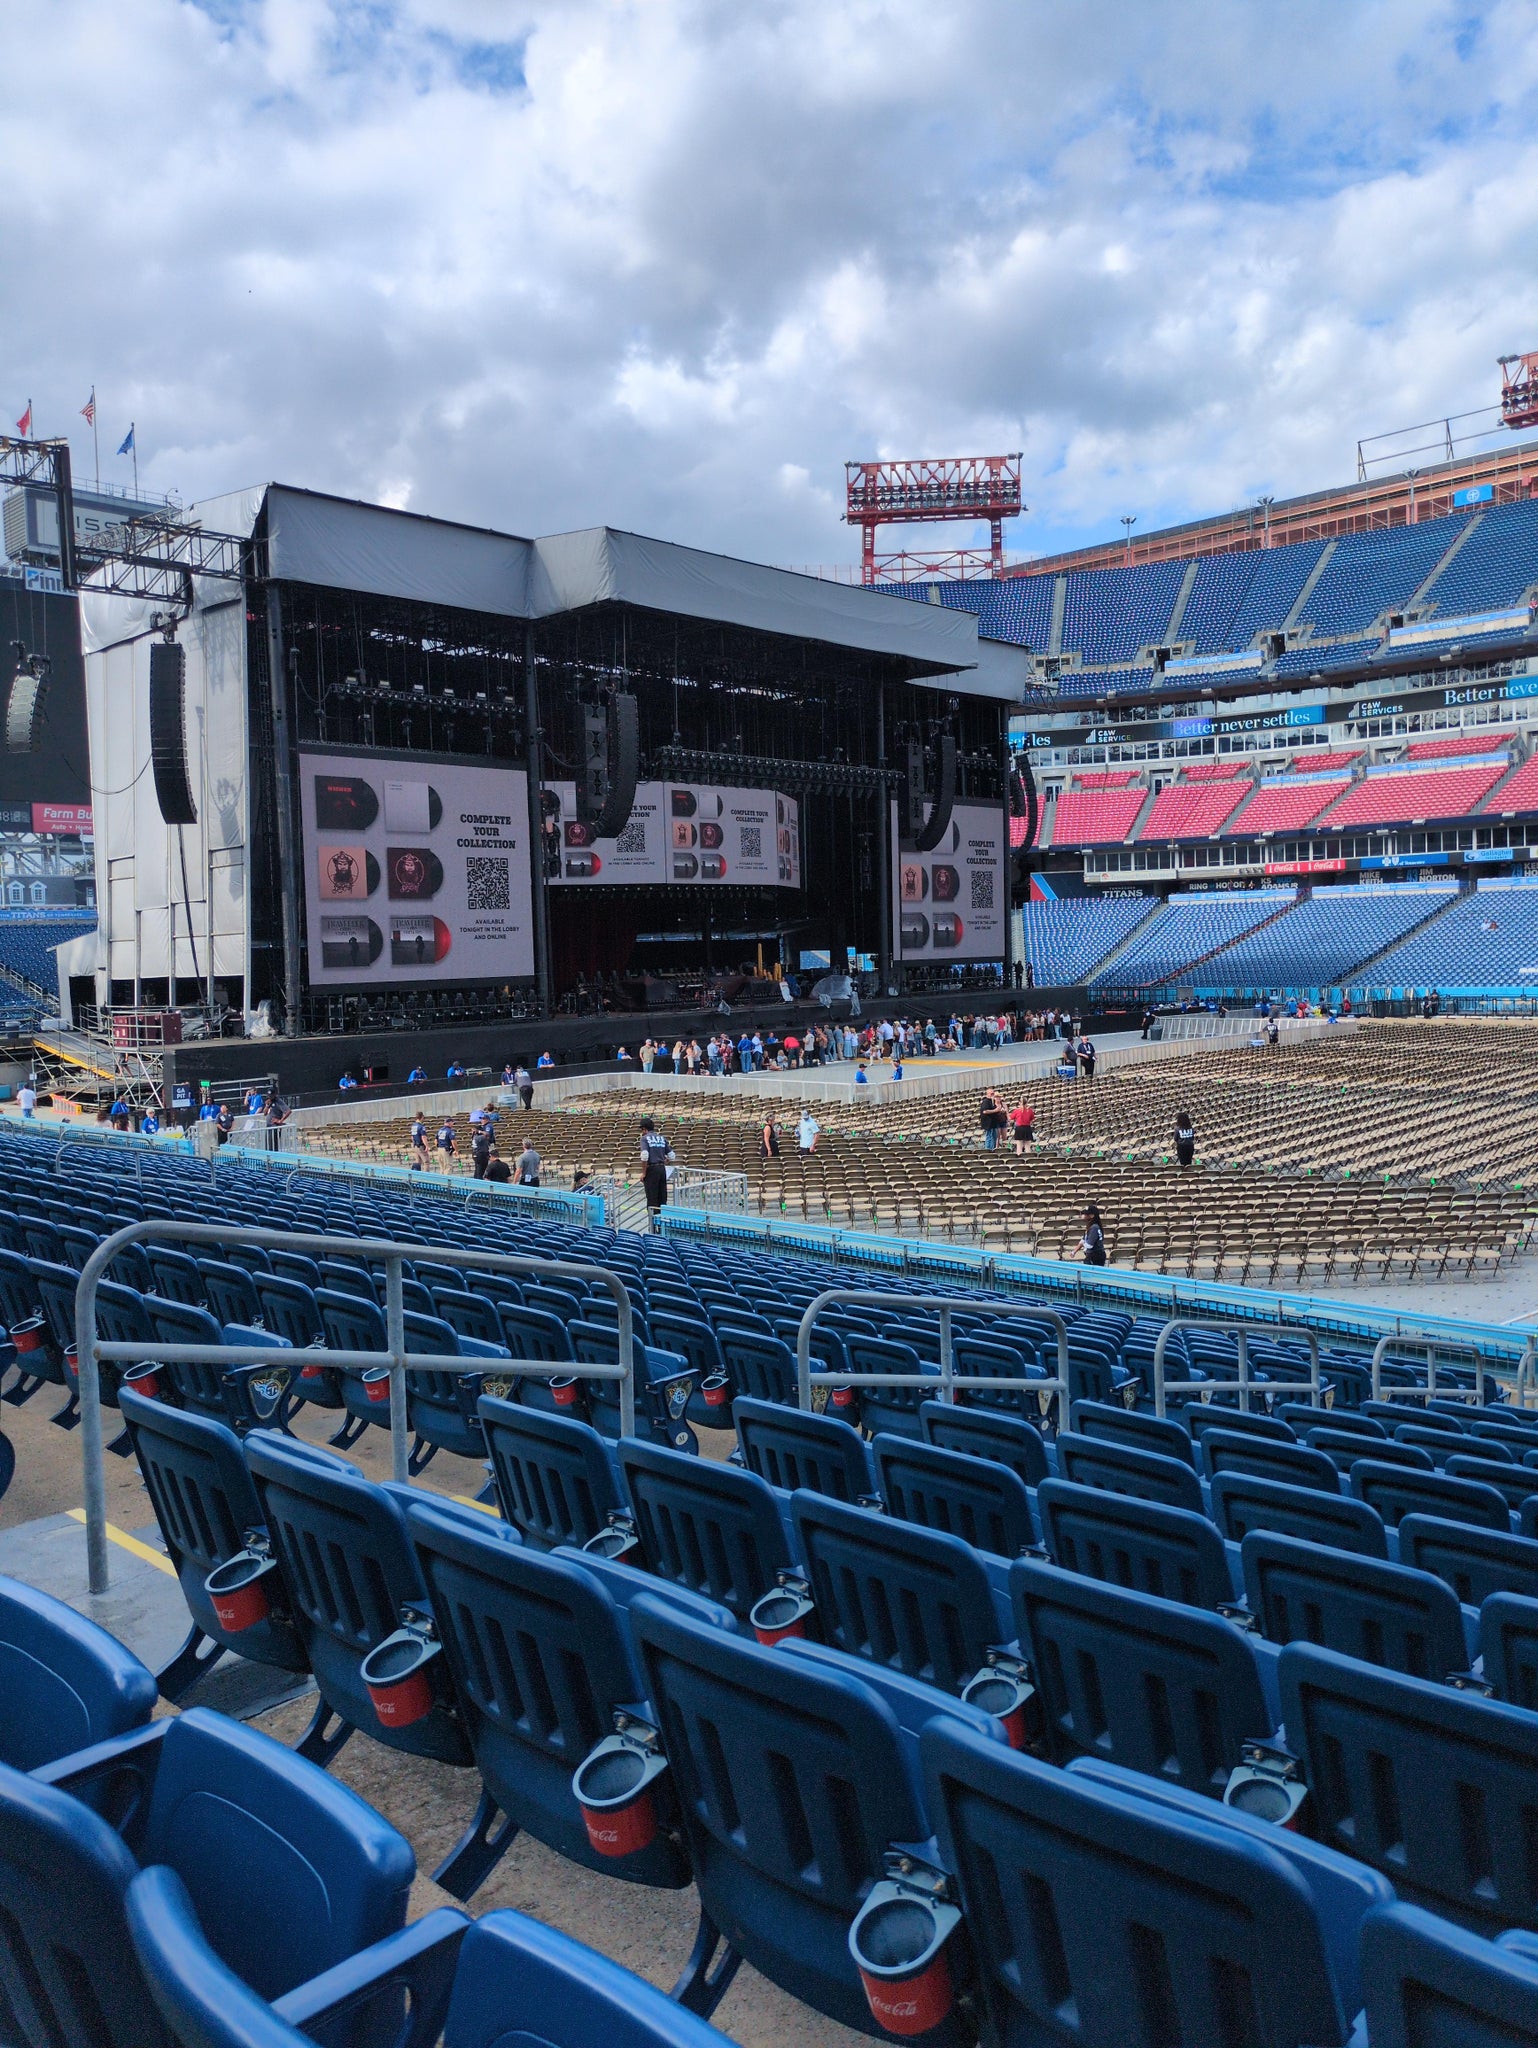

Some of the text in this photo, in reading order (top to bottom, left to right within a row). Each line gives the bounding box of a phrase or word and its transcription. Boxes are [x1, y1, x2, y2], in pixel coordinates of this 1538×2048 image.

[1444, 689, 1496, 706] Better
[1361, 701, 1381, 710] C&W
[1361, 705, 1404, 717] SERVICES
[1220, 718, 1260, 732] never
[1262, 710, 1311, 727] settles
[43, 808, 74, 819] Farm
[460, 814, 512, 825] COMPLETE
[473, 827, 500, 836] YOUR
[456, 839, 516, 849] COLLECTION
[968, 840, 995, 848] COMPLETE
[1419, 874, 1456, 883] NORTON
[1102, 889, 1144, 898] TITANS
[10, 911, 46, 919] TITANS
